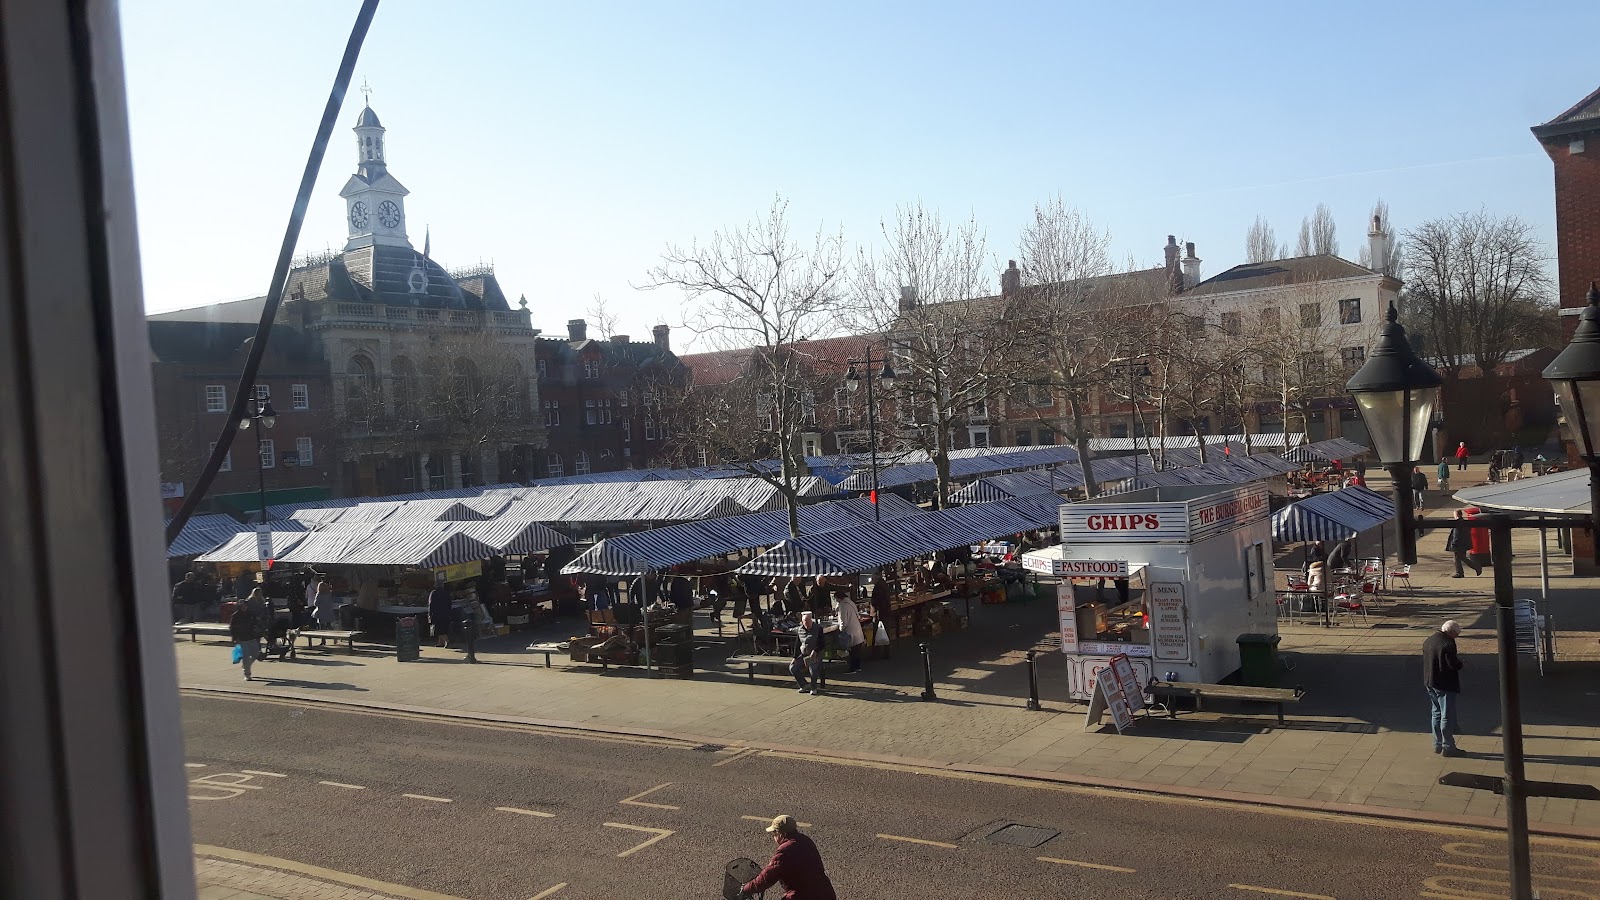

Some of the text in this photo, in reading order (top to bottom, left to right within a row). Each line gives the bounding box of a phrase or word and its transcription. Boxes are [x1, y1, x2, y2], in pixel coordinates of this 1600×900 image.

[1199, 495, 1262, 525] THE BURGER GRILL
[1087, 514, 1160, 531] CHIPS
[1027, 558, 1047, 571] CHIPS
[1061, 562, 1118, 573] FASTFOOD
